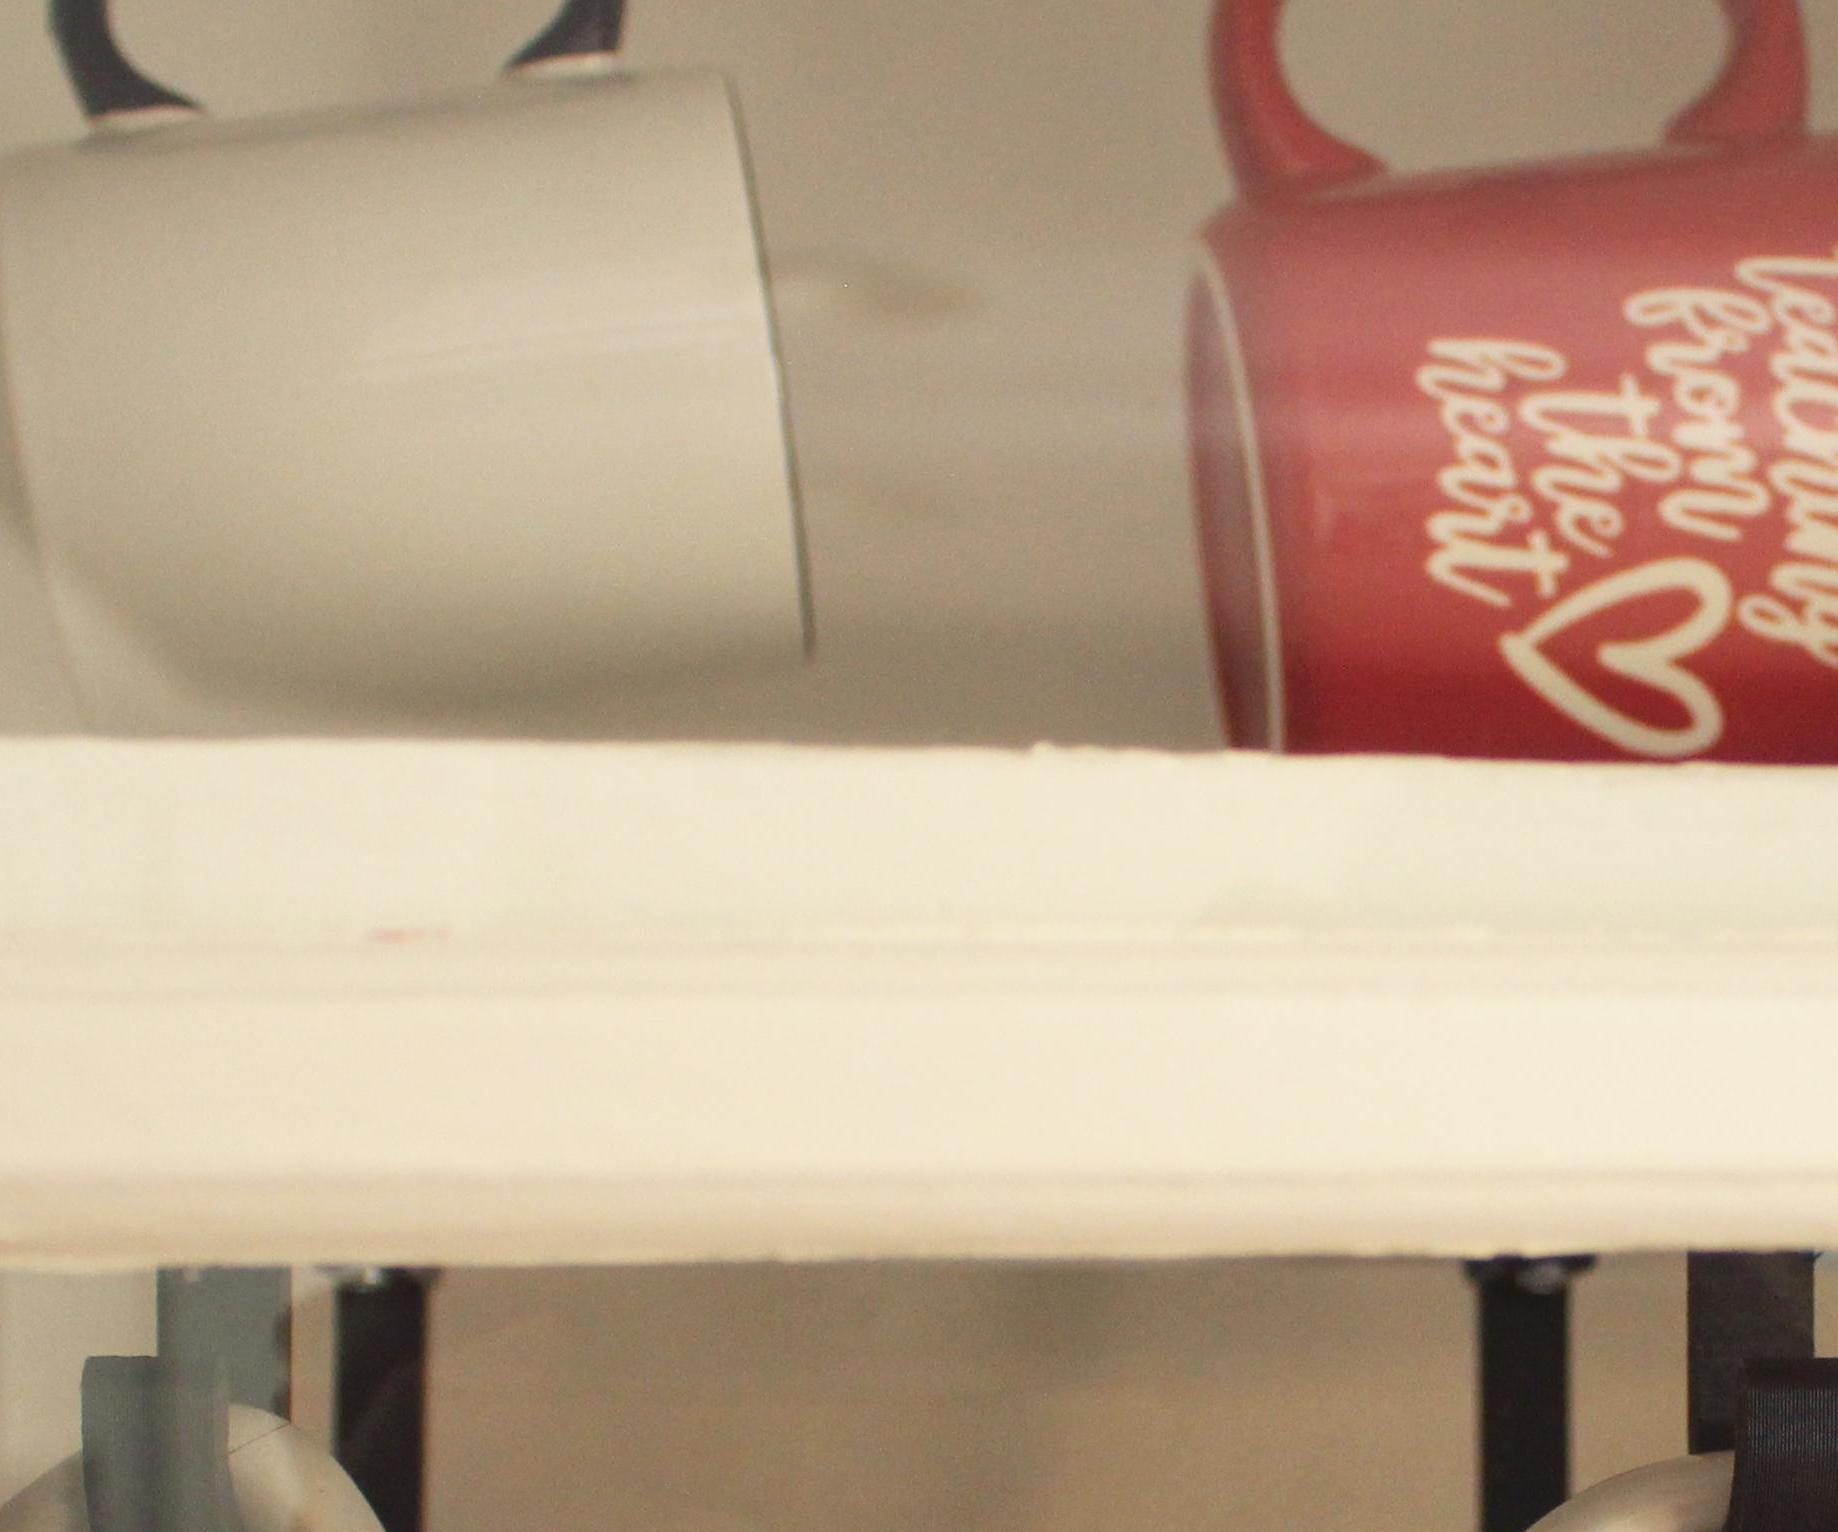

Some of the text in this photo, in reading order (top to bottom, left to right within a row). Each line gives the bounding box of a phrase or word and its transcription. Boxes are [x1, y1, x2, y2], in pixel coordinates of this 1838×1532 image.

[1416, 338, 1570, 608] heart
[1518, 373, 1683, 559] the
[1623, 287, 1770, 541] from
